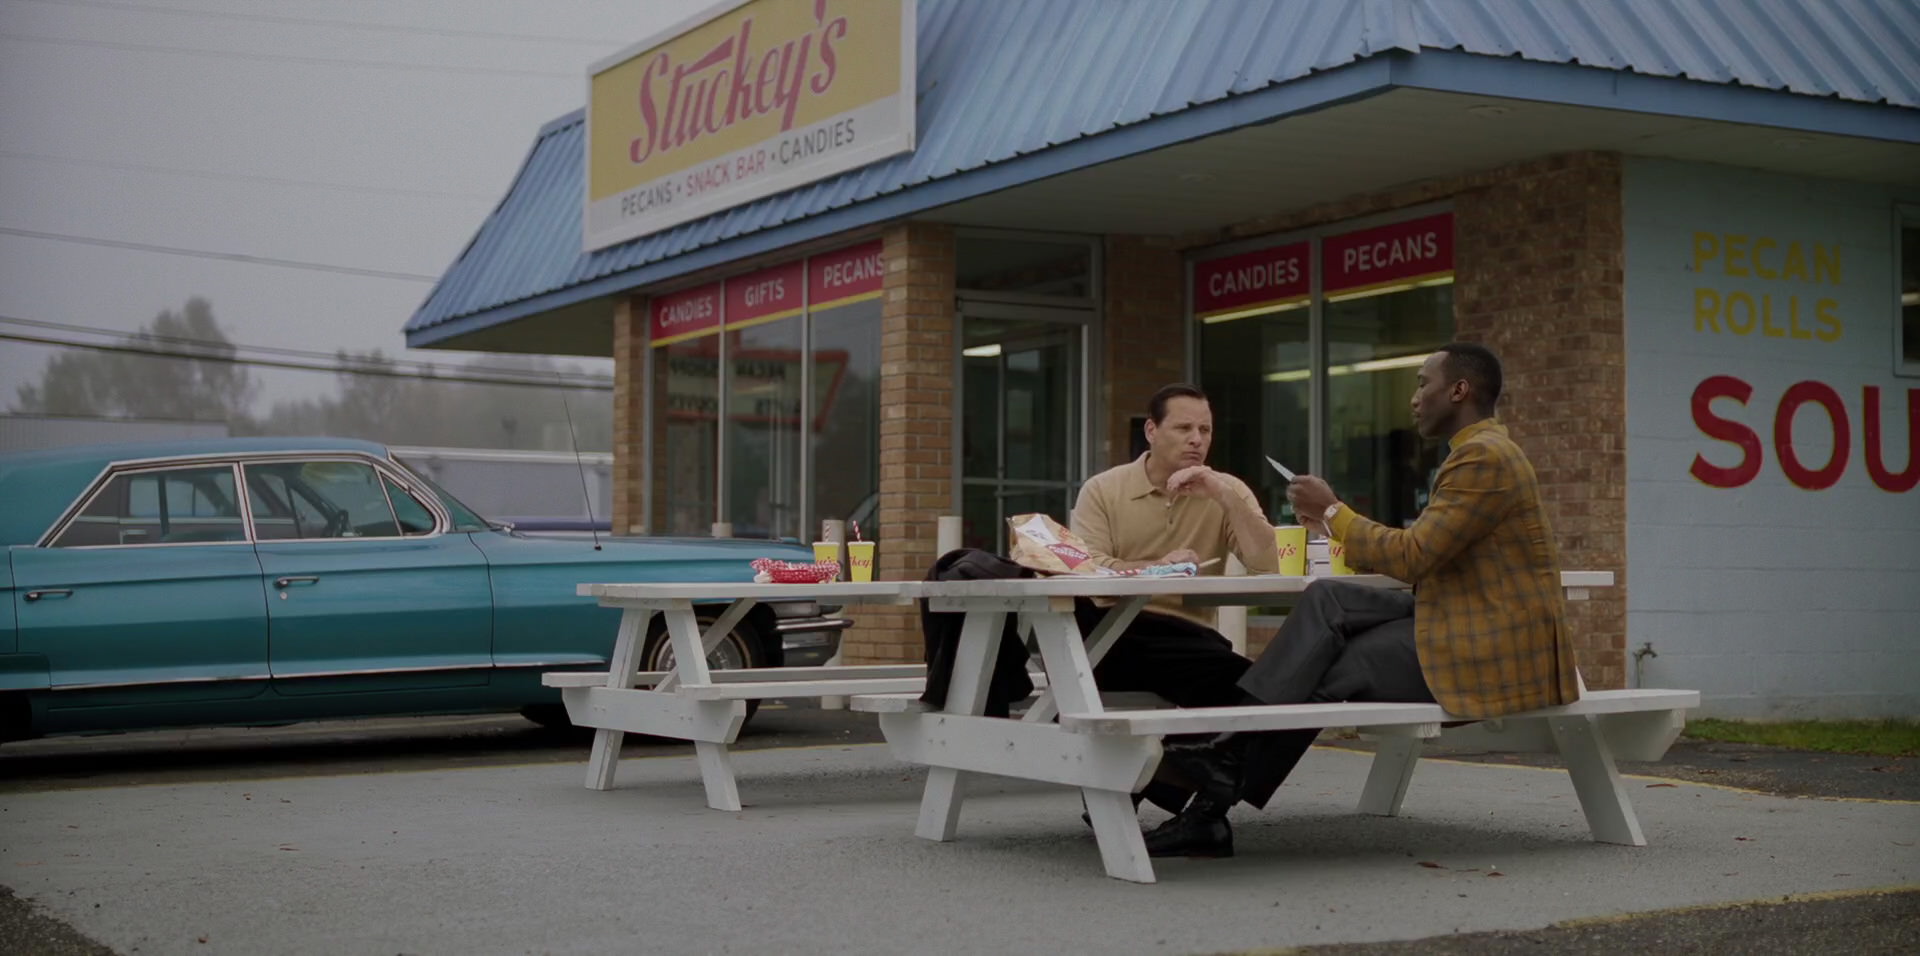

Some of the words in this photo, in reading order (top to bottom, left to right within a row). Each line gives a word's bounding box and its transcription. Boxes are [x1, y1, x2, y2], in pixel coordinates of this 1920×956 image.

[629, 0, 847, 164] Stuckey's
[621, 181, 673, 217] PECANS
[686, 164, 731, 197] SNACK
[736, 150, 766, 181] BAR
[779, 118, 856, 165] CANDIES
[823, 252, 885, 289] PECANS
[1344, 232, 1438, 274] PECANS
[1692, 231, 1842, 286] PECAN
[744, 278, 785, 308] GIFTS
[1209, 258, 1299, 297] CANDIES
[659, 296, 713, 328] CANDIES
[1693, 287, 1843, 342] ROLLS
[1689, 374, 1920, 494] SOU
